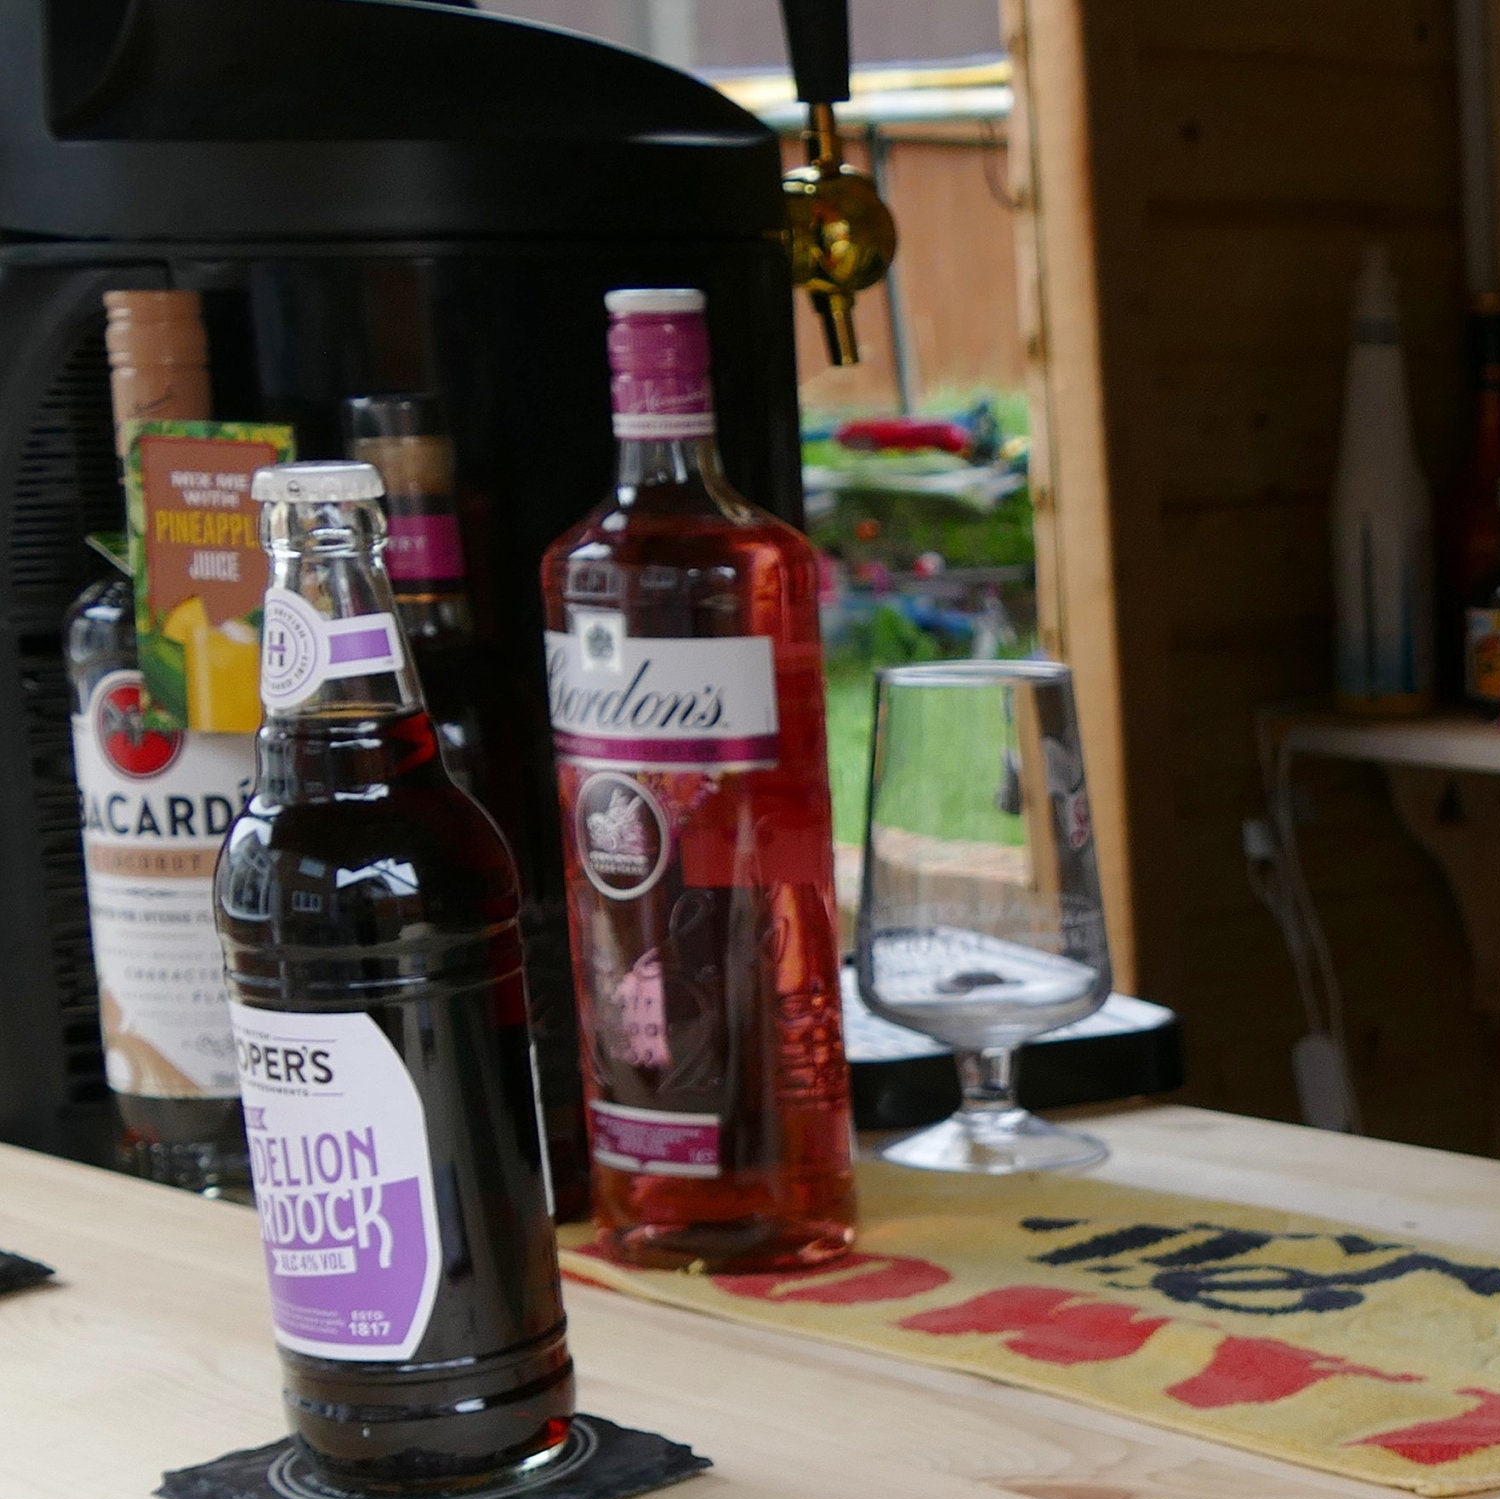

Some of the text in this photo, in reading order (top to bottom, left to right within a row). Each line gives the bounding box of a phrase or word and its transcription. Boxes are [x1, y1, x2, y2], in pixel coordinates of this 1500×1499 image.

[170, 471, 209, 488] MIX
[182, 489, 240, 507] WITH
[155, 510, 259, 548] PINEAPPL
[188, 551, 241, 582] JUICE
[253, 1125, 379, 1188] DELION
[300, 1253, 318, 1272] 4%
[320, 1252, 346, 1270] VOL
[348, 1320, 392, 1337] 1817
